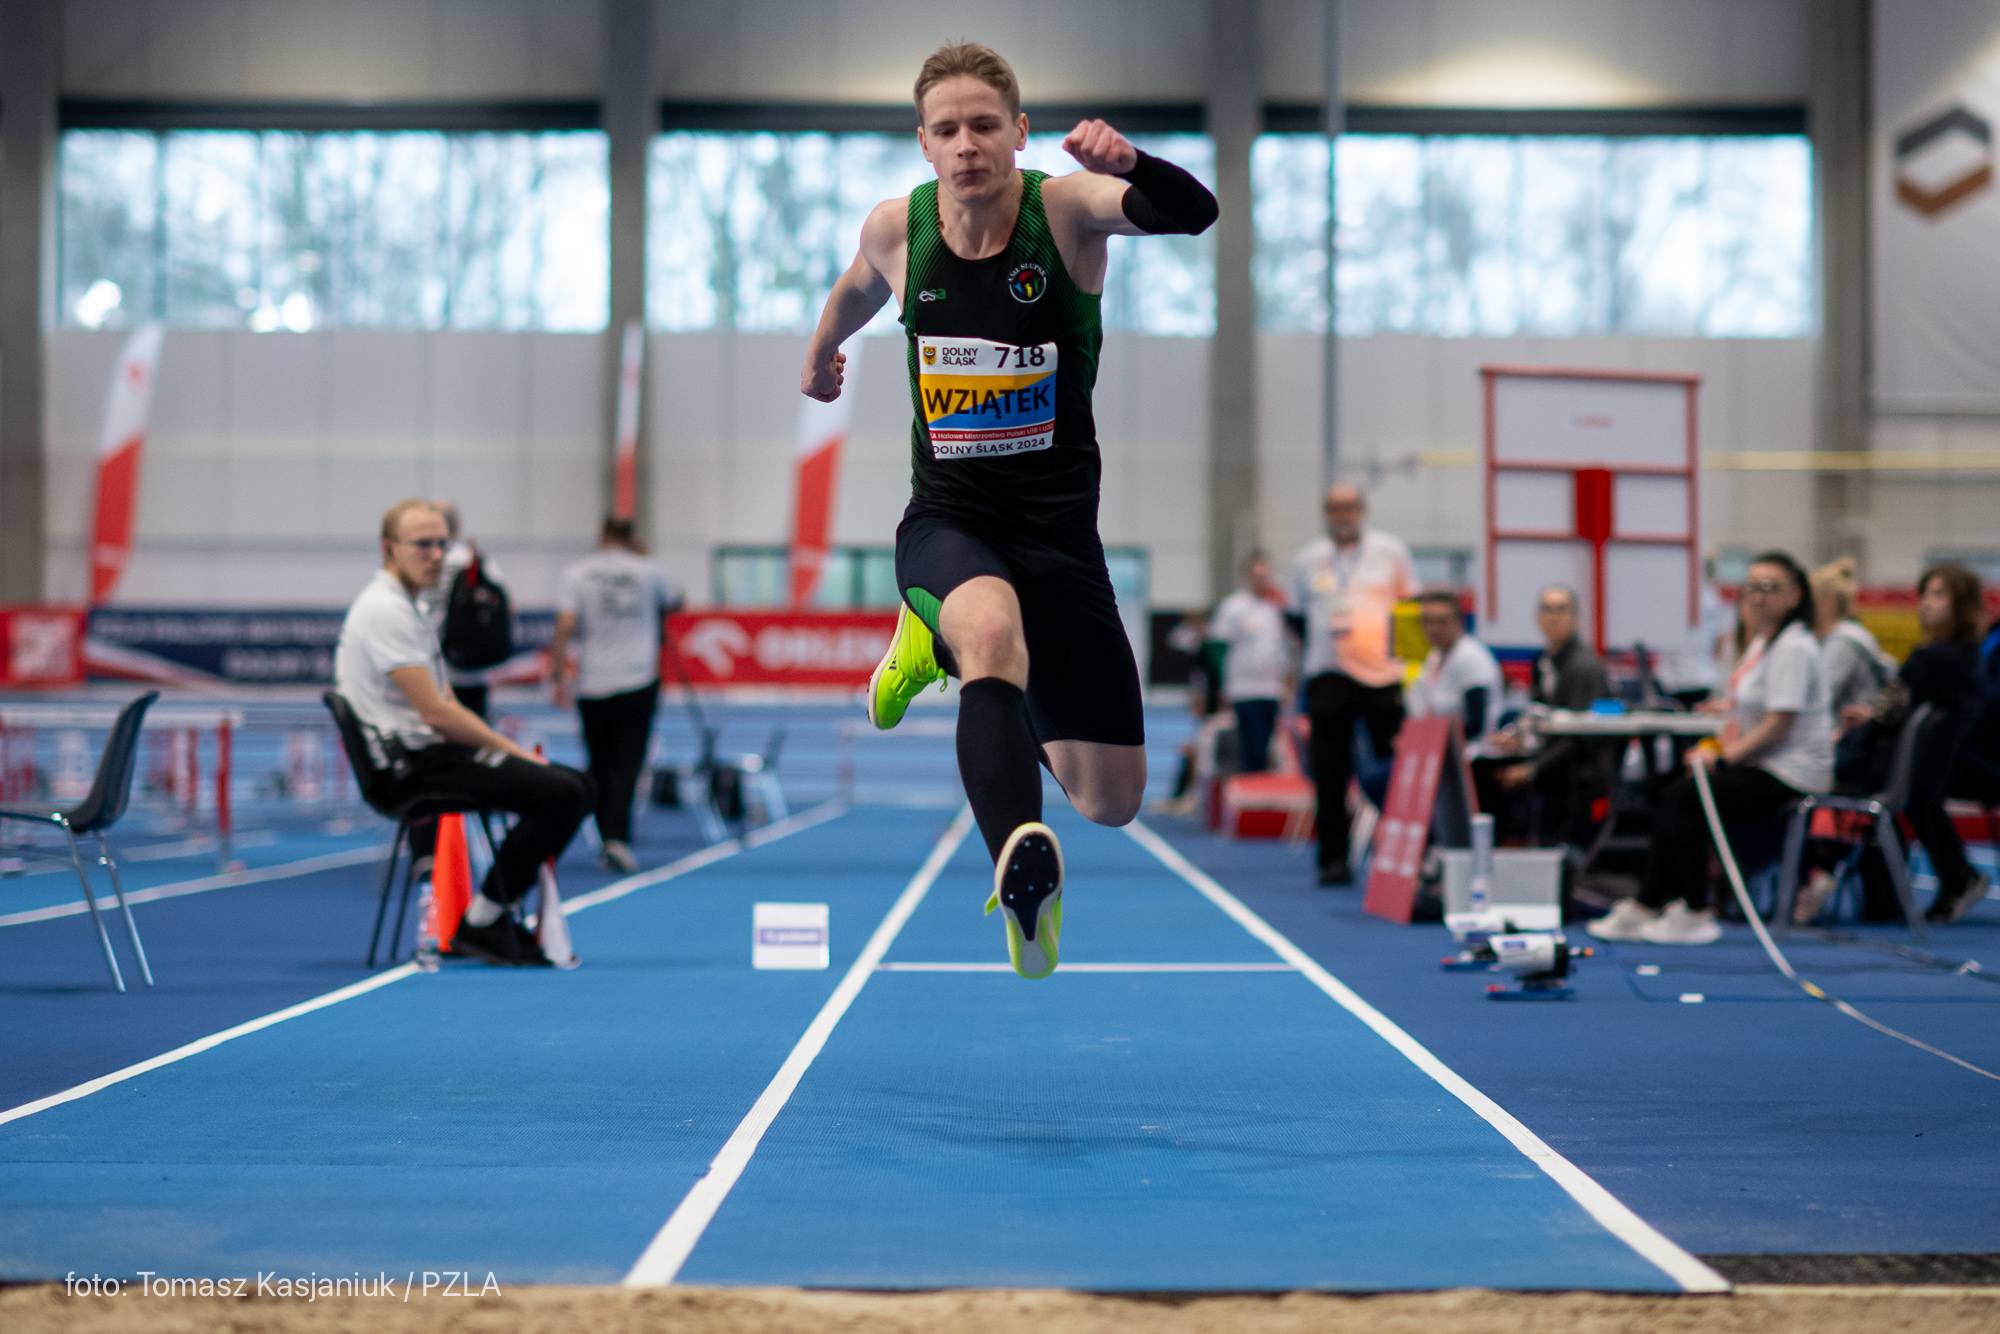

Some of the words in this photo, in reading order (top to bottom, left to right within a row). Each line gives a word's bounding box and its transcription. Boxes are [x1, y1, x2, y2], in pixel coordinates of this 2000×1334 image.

[942, 347, 978, 357] DOLNY
[994, 346, 1046, 368] 718
[942, 355, 977, 367] ŚLĄSK
[924, 384, 1051, 420] WZIĄTEK
[937, 432, 964, 440] Halowe
[1006, 429, 1026, 438] Polski
[933, 445, 973, 455] DOLNY
[975, 442, 1014, 455] ŚLĄSK
[1016, 437, 1046, 450] 2024
